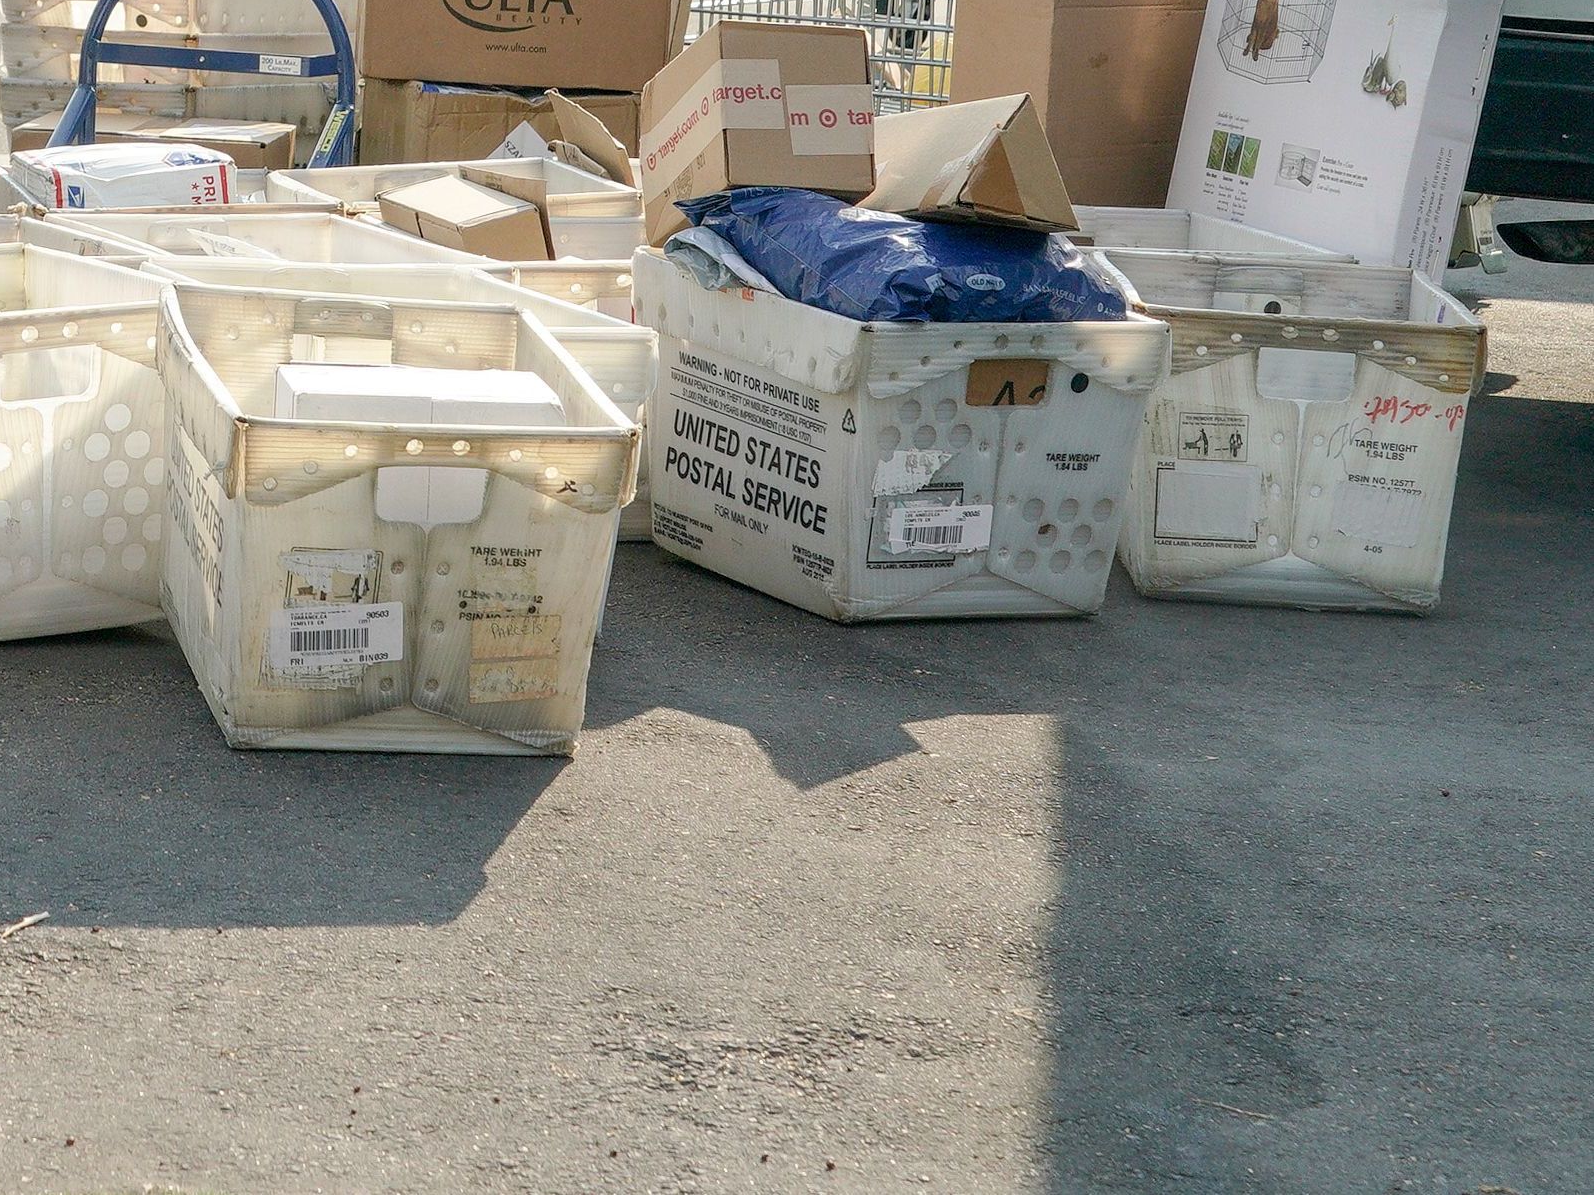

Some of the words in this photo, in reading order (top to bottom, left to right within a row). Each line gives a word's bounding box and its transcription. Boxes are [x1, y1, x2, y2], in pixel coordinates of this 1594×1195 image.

[496, 13, 582, 25] BEAUTY
[486, 43, 547, 53] www.ulta.com
[321, 110, 349, 152] WESCO
[658, 109, 700, 159] target.com
[971, 278, 985, 286] OLD
[679, 350, 717, 376] WARNING
[723, 368, 742, 385] NOT
[744, 375, 761, 392] FOR
[763, 383, 799, 407] PRIVATE
[802, 396, 820, 413] USE
[693, 379, 715, 395] PENALTY
[715, 386, 727, 398] FOR
[727, 389, 742, 404] THEFT
[742, 396, 751, 405] OR
[770, 406, 778, 417] OF
[778, 409, 798, 426] POSTAL
[797, 415, 827, 434] PROPERTY
[708, 396, 719, 409] AND
[740, 409, 778, 429] IMPRISONMENT
[674, 408, 740, 458] UNITED
[745, 436, 821, 489] STATES
[1355, 440, 1378, 449] TARE
[1380, 441, 1418, 453] WEIGHT
[1046, 454, 1067, 462] TARE
[1069, 454, 1100, 462] WEIGHT
[1366, 450, 1383, 459] 1.94
[1386, 453, 1405, 461] LBS
[1348, 474, 1370, 484] PSIN
[1372, 477, 1387, 485] NO.
[1390, 479, 1415, 487] 1257T
[665, 446, 736, 500] POSTAL
[742, 477, 827, 535] SERVICE
[166, 468, 190, 547] POSTAL
[195, 477, 224, 553] STATES
[714, 504, 730, 519] FOR
[731, 510, 747, 528] MAIL
[748, 518, 769, 535] ONLY
[471, 546, 497, 556] TARE
[1364, 545, 1383, 553] 4-05
[507, 558, 527, 567] LBS
[366, 610, 390, 619] 90503
